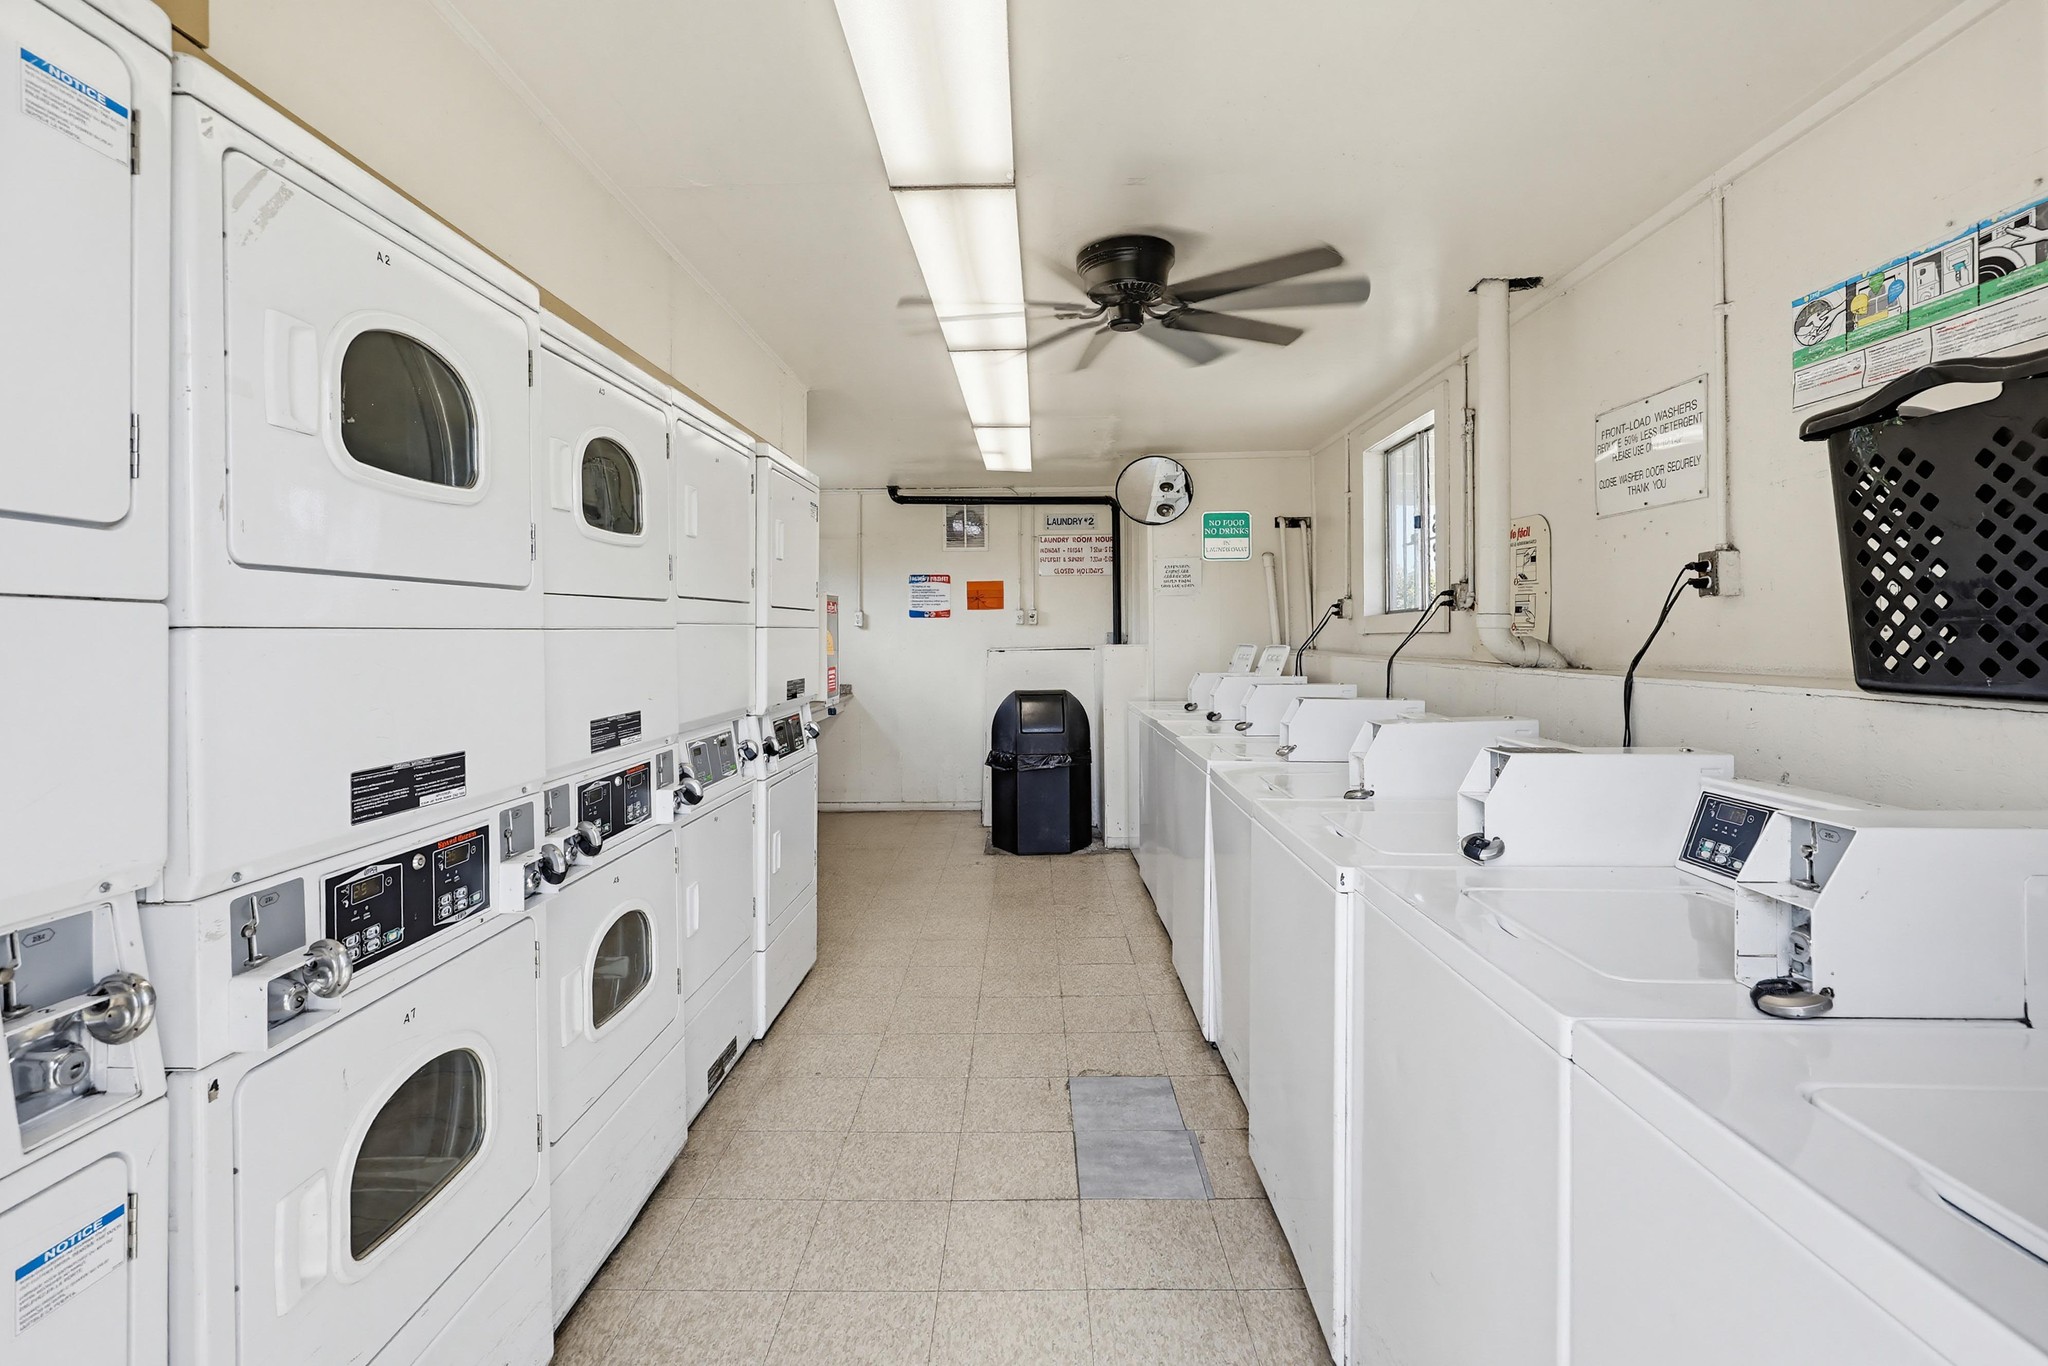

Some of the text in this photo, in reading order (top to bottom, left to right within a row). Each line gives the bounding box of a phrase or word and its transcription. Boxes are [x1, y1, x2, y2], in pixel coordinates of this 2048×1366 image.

[49, 65, 106, 105] NOTICE
[377, 251, 391, 266] A2
[1602, 399, 1698, 440] FRONT-LOAD WASHERS
[1641, 427, 1658, 440] LESS
[1660, 412, 1703, 434] DETERGENT
[1612, 448, 1632, 461] PLEASE
[1633, 444, 1645, 457] USE
[1599, 455, 1701, 490] CLOSE WASHER DOOR SECURELY
[1628, 478, 1667, 495] THANK YOU
[1046, 517, 1083, 526] LAUNDRY
[1209, 519, 1245, 527] NO FOOD
[1205, 527, 1249, 535] NO DRINKS
[1053, 567, 1104, 575] CLOSED HOLIDAYS
[403, 1007, 416, 1025] A7
[44, 1218, 103, 1261] NOTICE
